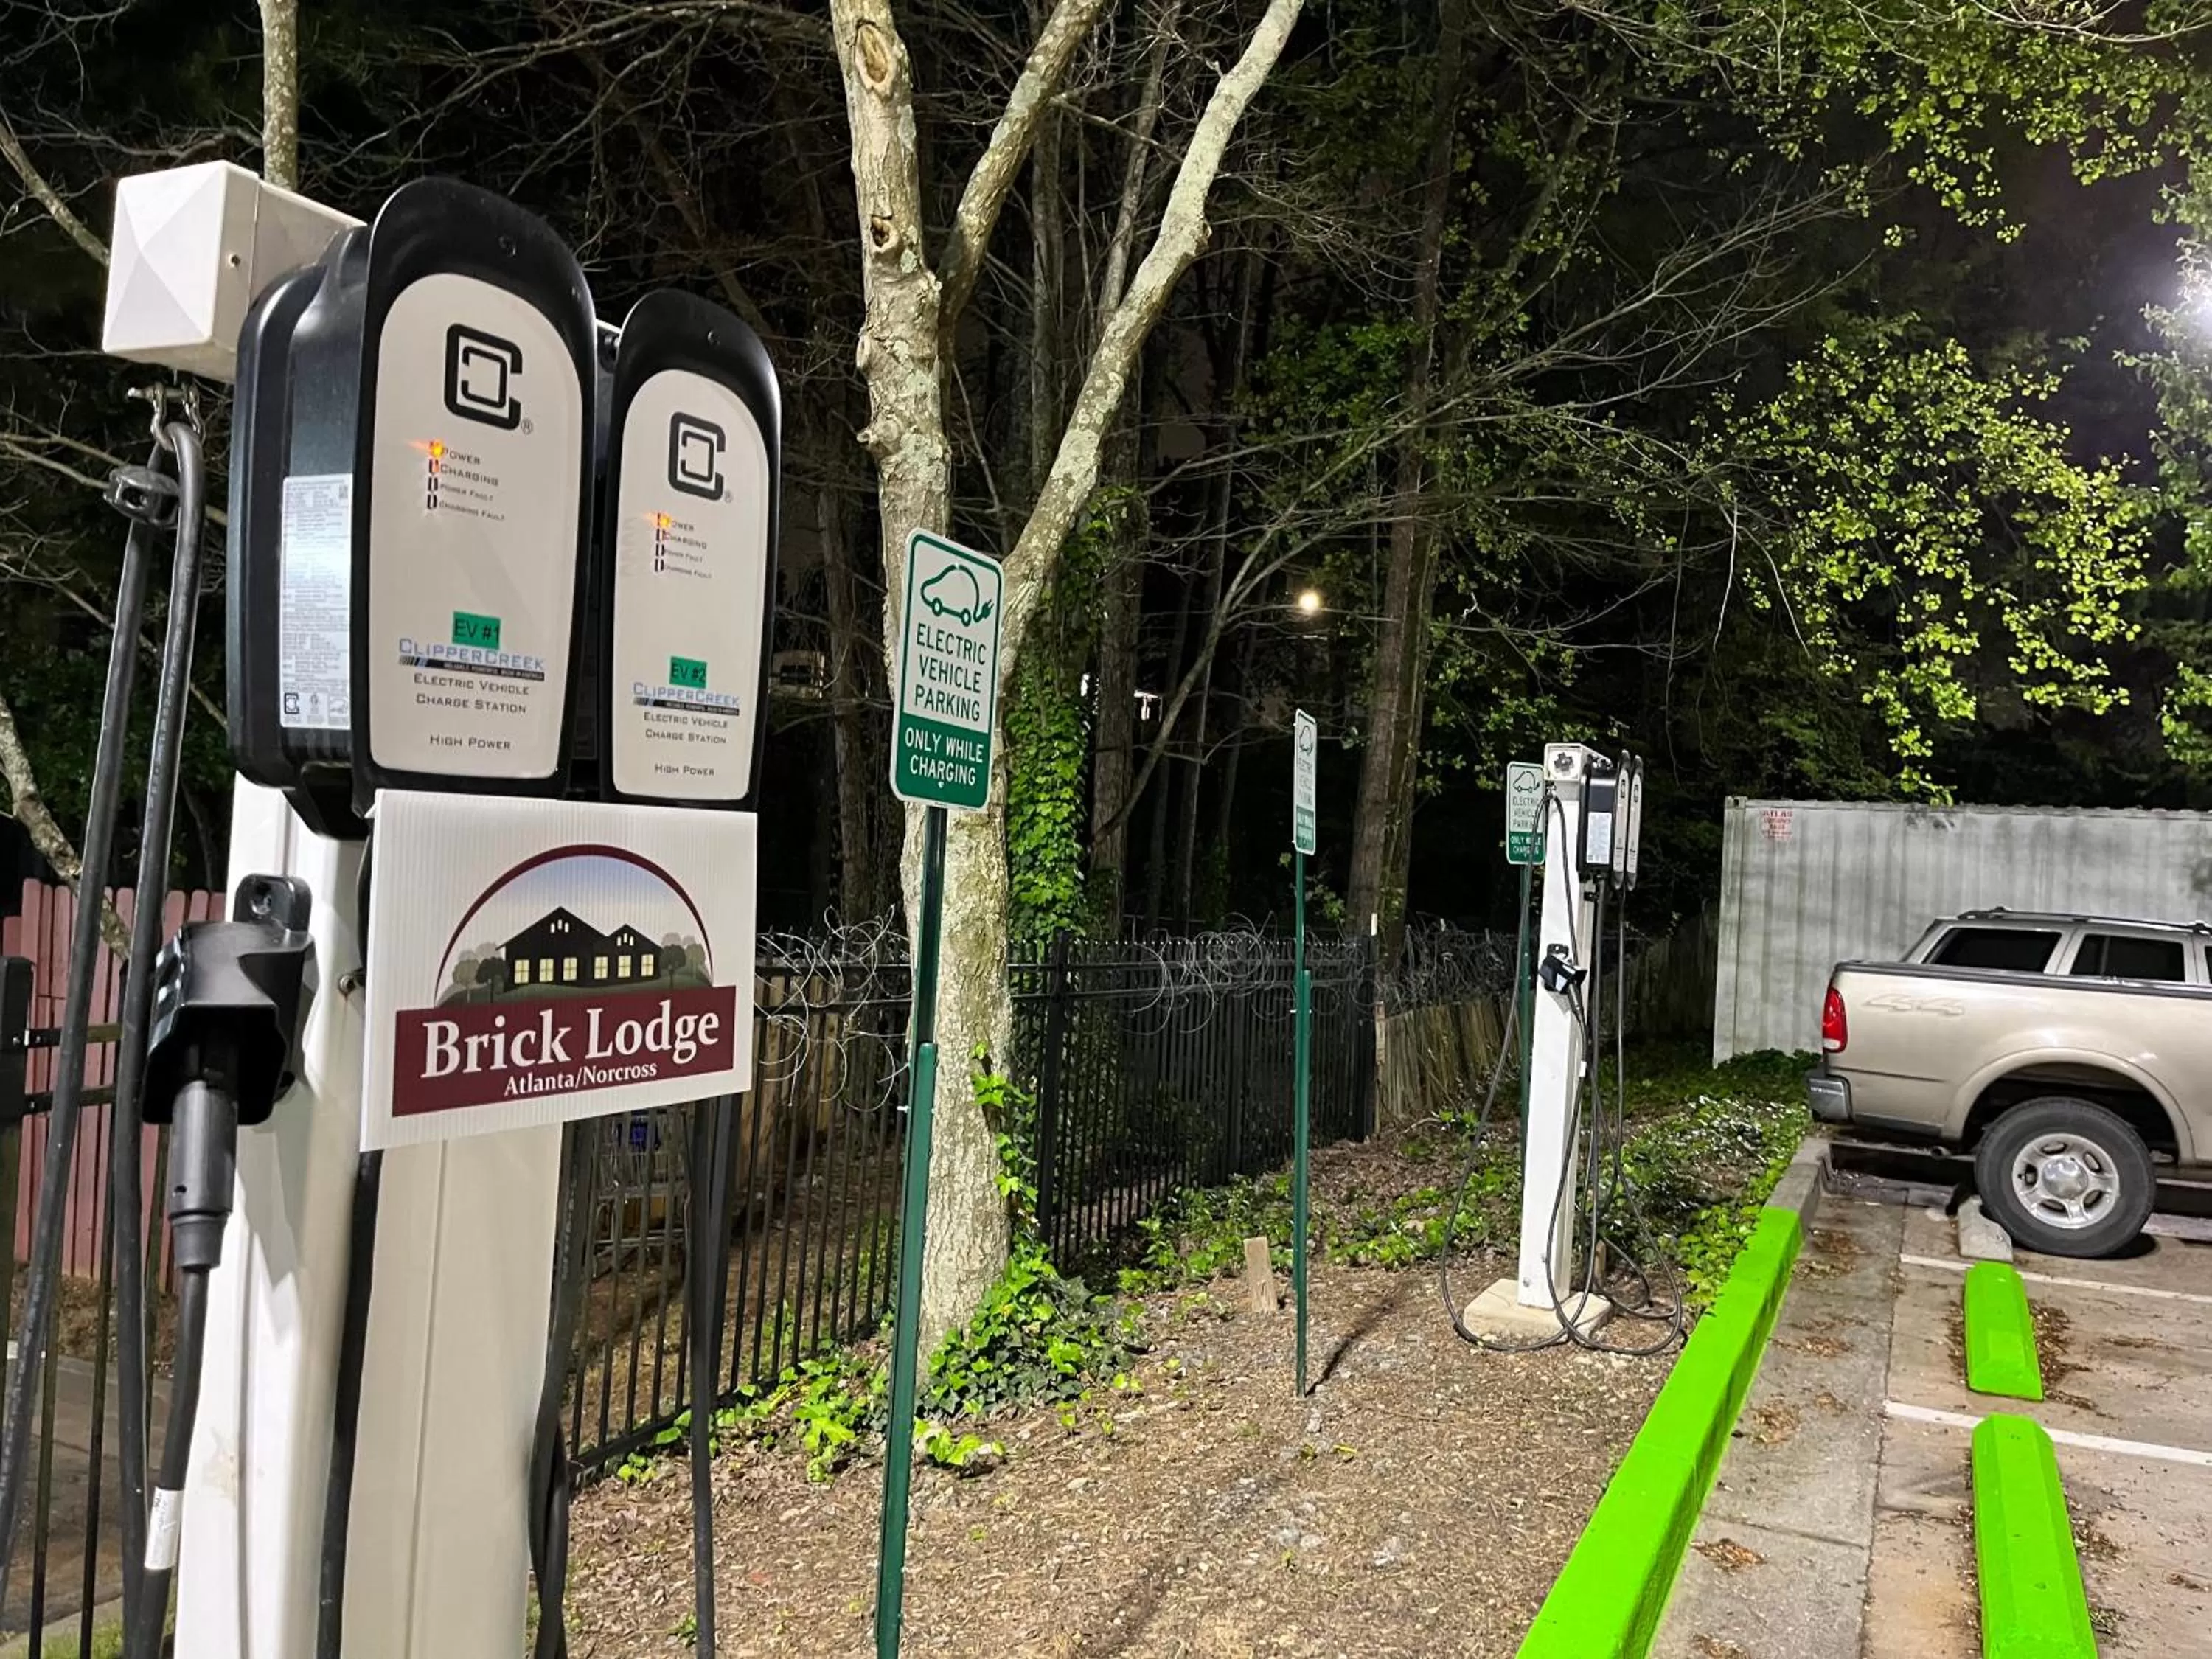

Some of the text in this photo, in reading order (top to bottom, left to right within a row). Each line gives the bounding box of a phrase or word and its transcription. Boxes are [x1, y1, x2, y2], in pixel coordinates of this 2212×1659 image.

[453, 619, 500, 644] EV #1
[917, 622, 987, 665] ELECTRIC
[672, 664, 687, 679] EV
[919, 654, 982, 694] VEHICLE
[915, 684, 980, 722] PARKING
[905, 726, 984, 763] ONLY WHILE
[910, 754, 976, 786] CHARGING
[420, 998, 720, 1079] Brick Lodge
[504, 1061, 658, 1096] Atlanta/Norcross
